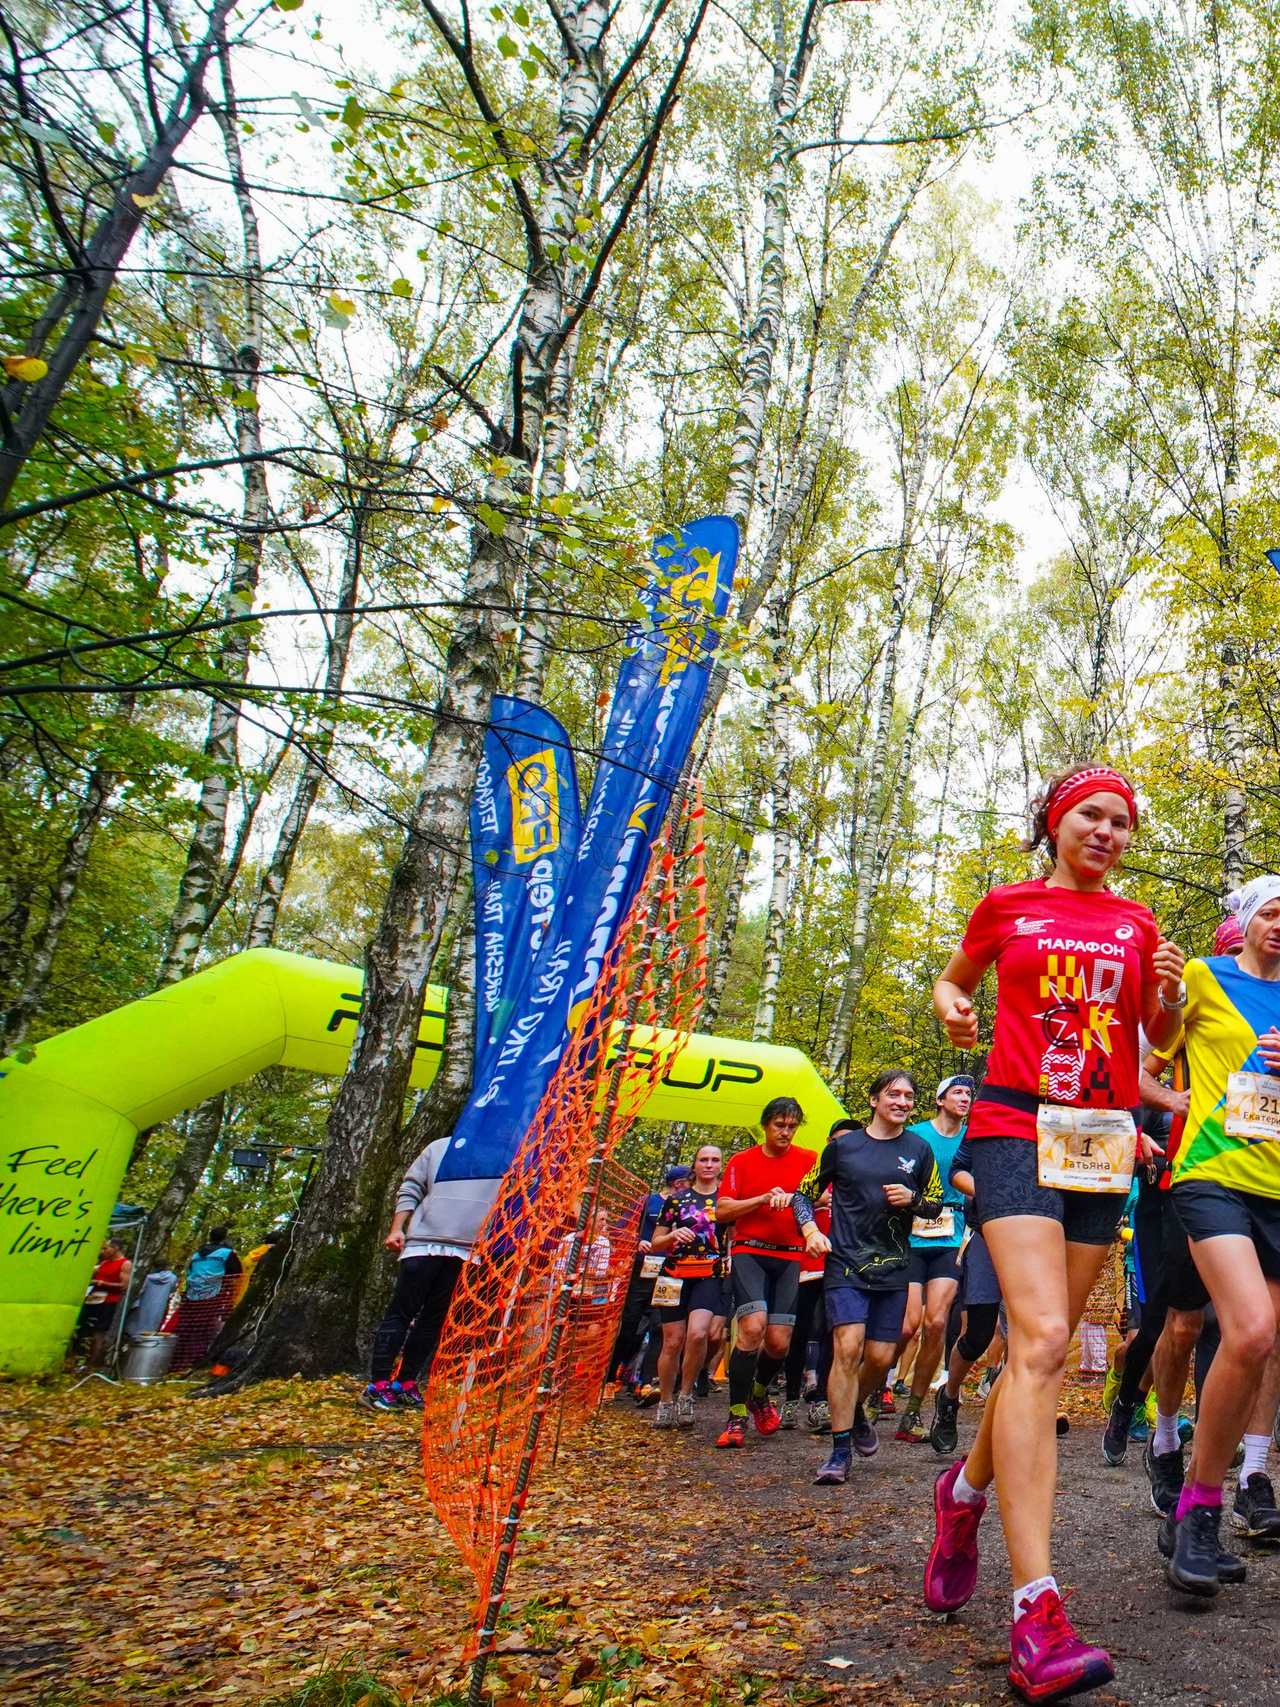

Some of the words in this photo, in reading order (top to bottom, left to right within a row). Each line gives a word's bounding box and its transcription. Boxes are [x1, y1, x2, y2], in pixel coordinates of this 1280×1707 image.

[1037, 938, 1126, 958] МАРАФОН
[1259, 1096, 1280, 1115] 21
[1080, 1137, 1093, 1158] 1
[6, 1144, 98, 1179] Feel
[1063, 1157, 1111, 1171] Татьяна
[8, 1222, 92, 1259] limit
